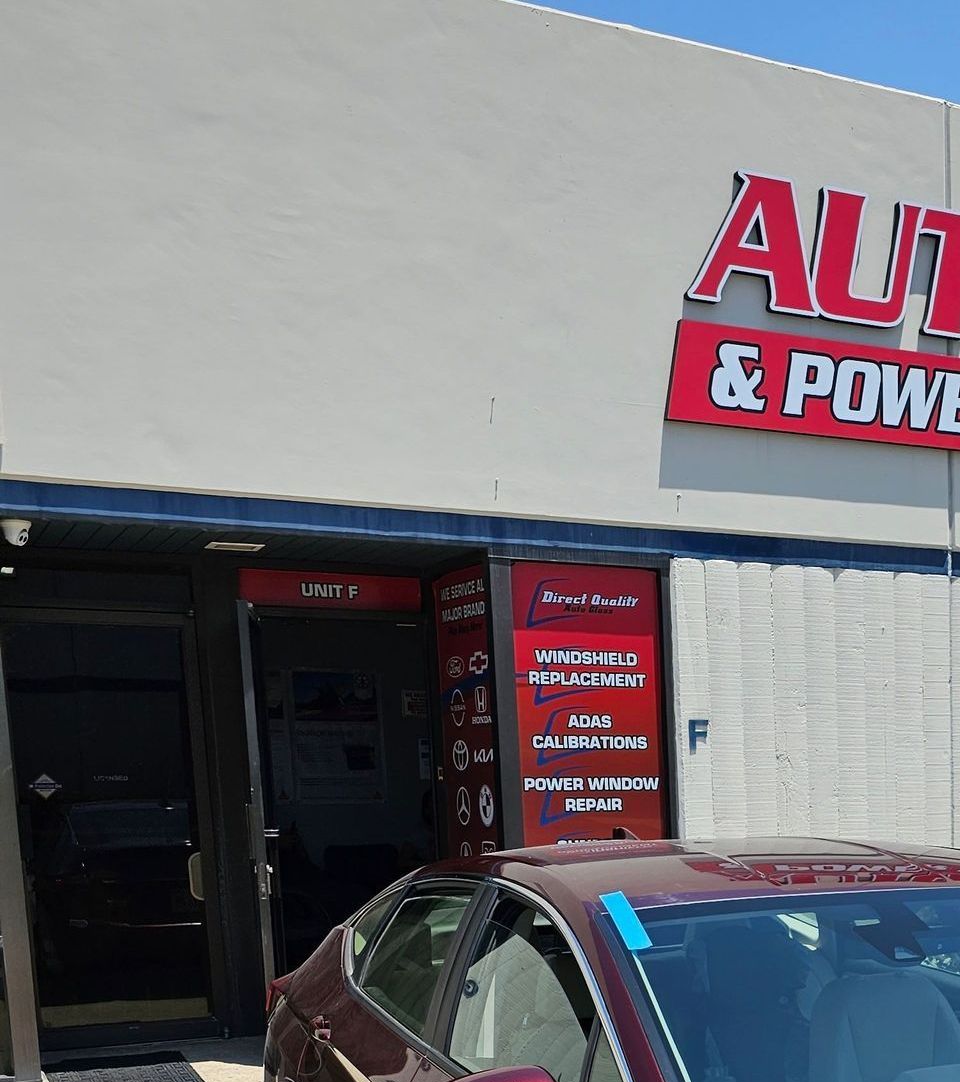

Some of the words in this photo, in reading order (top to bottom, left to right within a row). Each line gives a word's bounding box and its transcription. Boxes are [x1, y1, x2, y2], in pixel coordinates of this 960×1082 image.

[709, 341, 767, 412] &
[301, 583, 343, 599] UNIT
[348, 585, 358, 599] F
[441, 587, 450, 602] WE
[541, 590, 588, 605] Direct
[590, 594, 639, 608] Quality
[442, 605, 463, 623] MAJOR
[563, 604, 586, 613] Auto
[588, 605, 614, 615] Glass
[534, 649, 639, 667] WINDSHIELD
[527, 670, 647, 688] REPLACEMENT
[471, 715, 492, 725] HONDA
[567, 714, 612, 728] ADAS
[532, 735, 649, 750] CALIBRATIONS
[524, 777, 584, 791] POWER
[587, 777, 660, 791] WINDOW
[565, 798, 623, 812] REPAIR
